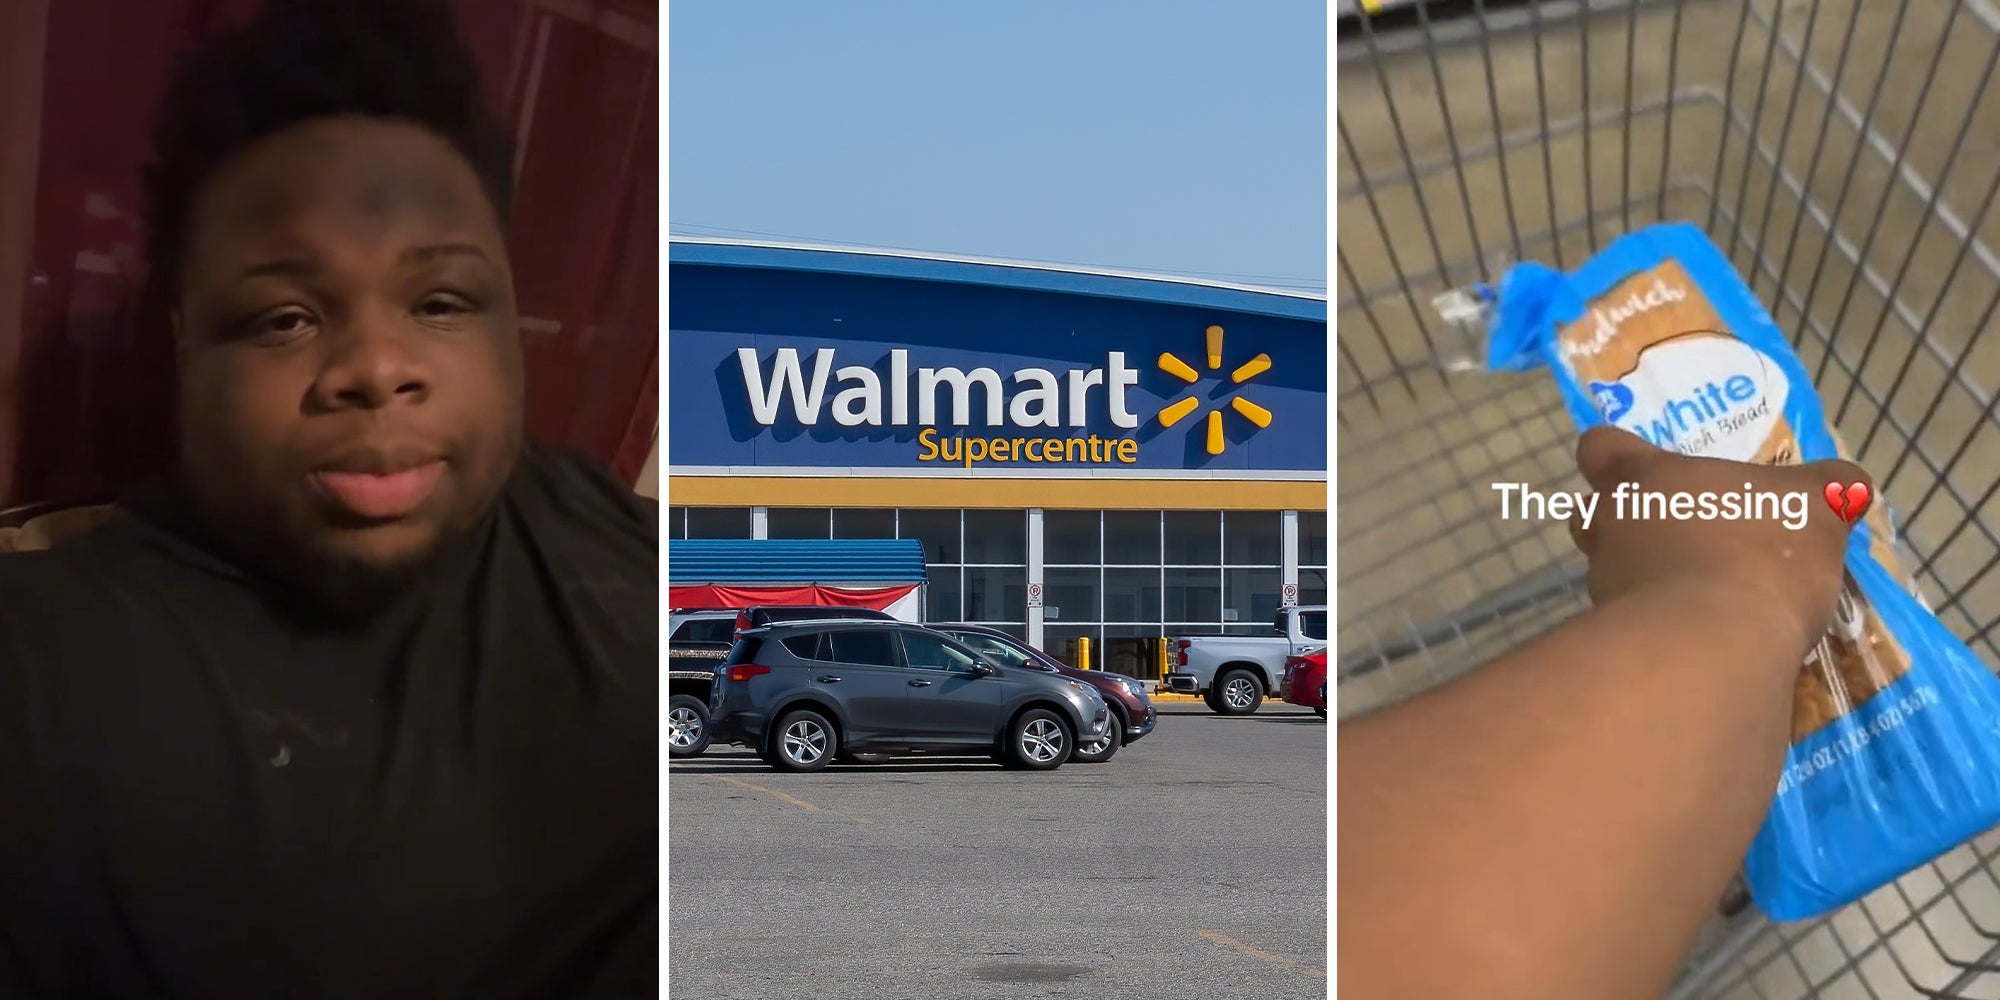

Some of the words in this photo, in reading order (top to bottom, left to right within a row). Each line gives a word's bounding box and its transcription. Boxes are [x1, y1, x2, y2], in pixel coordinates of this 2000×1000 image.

[737, 348, 1139, 427] Walmart
[1717, 397, 1770, 435] Bread
[918, 428, 1139, 469] Supercentre
[1812, 746, 1836, 770] OZ
